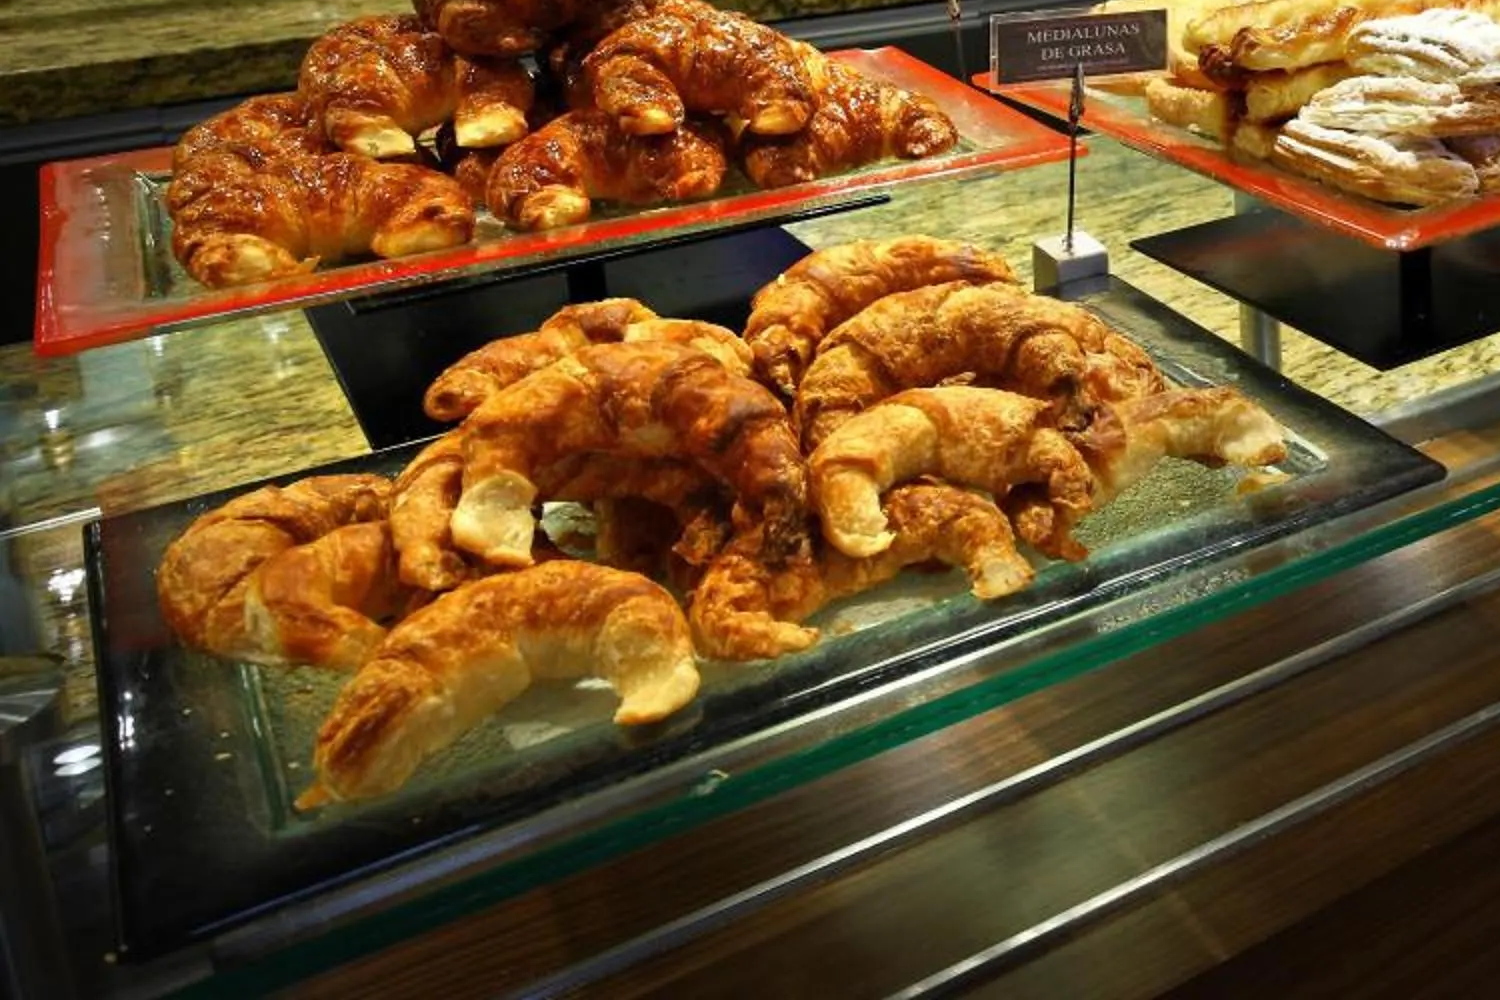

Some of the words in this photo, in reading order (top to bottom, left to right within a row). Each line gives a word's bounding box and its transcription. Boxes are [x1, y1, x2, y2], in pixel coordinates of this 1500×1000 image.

[1026, 23, 1140, 44] MEDIALUNAS
[1040, 47, 1065, 61] DE
[1068, 41, 1127, 58] GRASA
